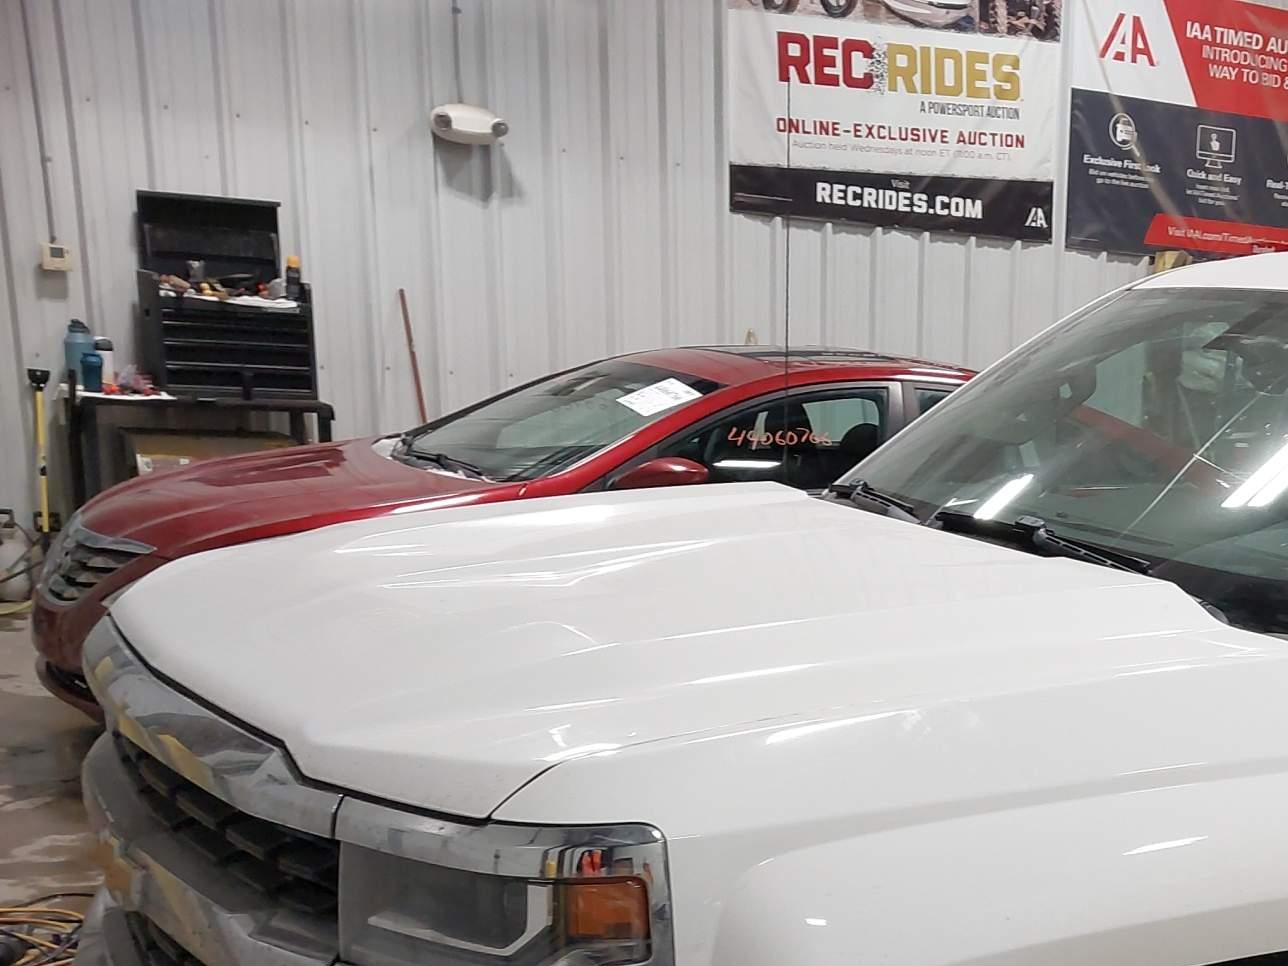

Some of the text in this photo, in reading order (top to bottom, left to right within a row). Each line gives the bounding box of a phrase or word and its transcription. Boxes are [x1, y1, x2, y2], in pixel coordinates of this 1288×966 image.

[1186, 20, 1212, 42] IAA
[1214, 26, 1263, 50] TIMED
[1202, 44, 1288, 73] INTRODUCING
[1208, 63, 1239, 80] WAY
[1241, 68, 1259, 84] TO
[1261, 72, 1281, 88] BID
[927, 102, 984, 118] POWERSPORT
[986, 106, 1020, 120] AUCTION
[776, 117, 1025, 149] ONLINE-EXCLUSIVE AUCTION
[816, 182, 983, 219] RECRIDES.COM
